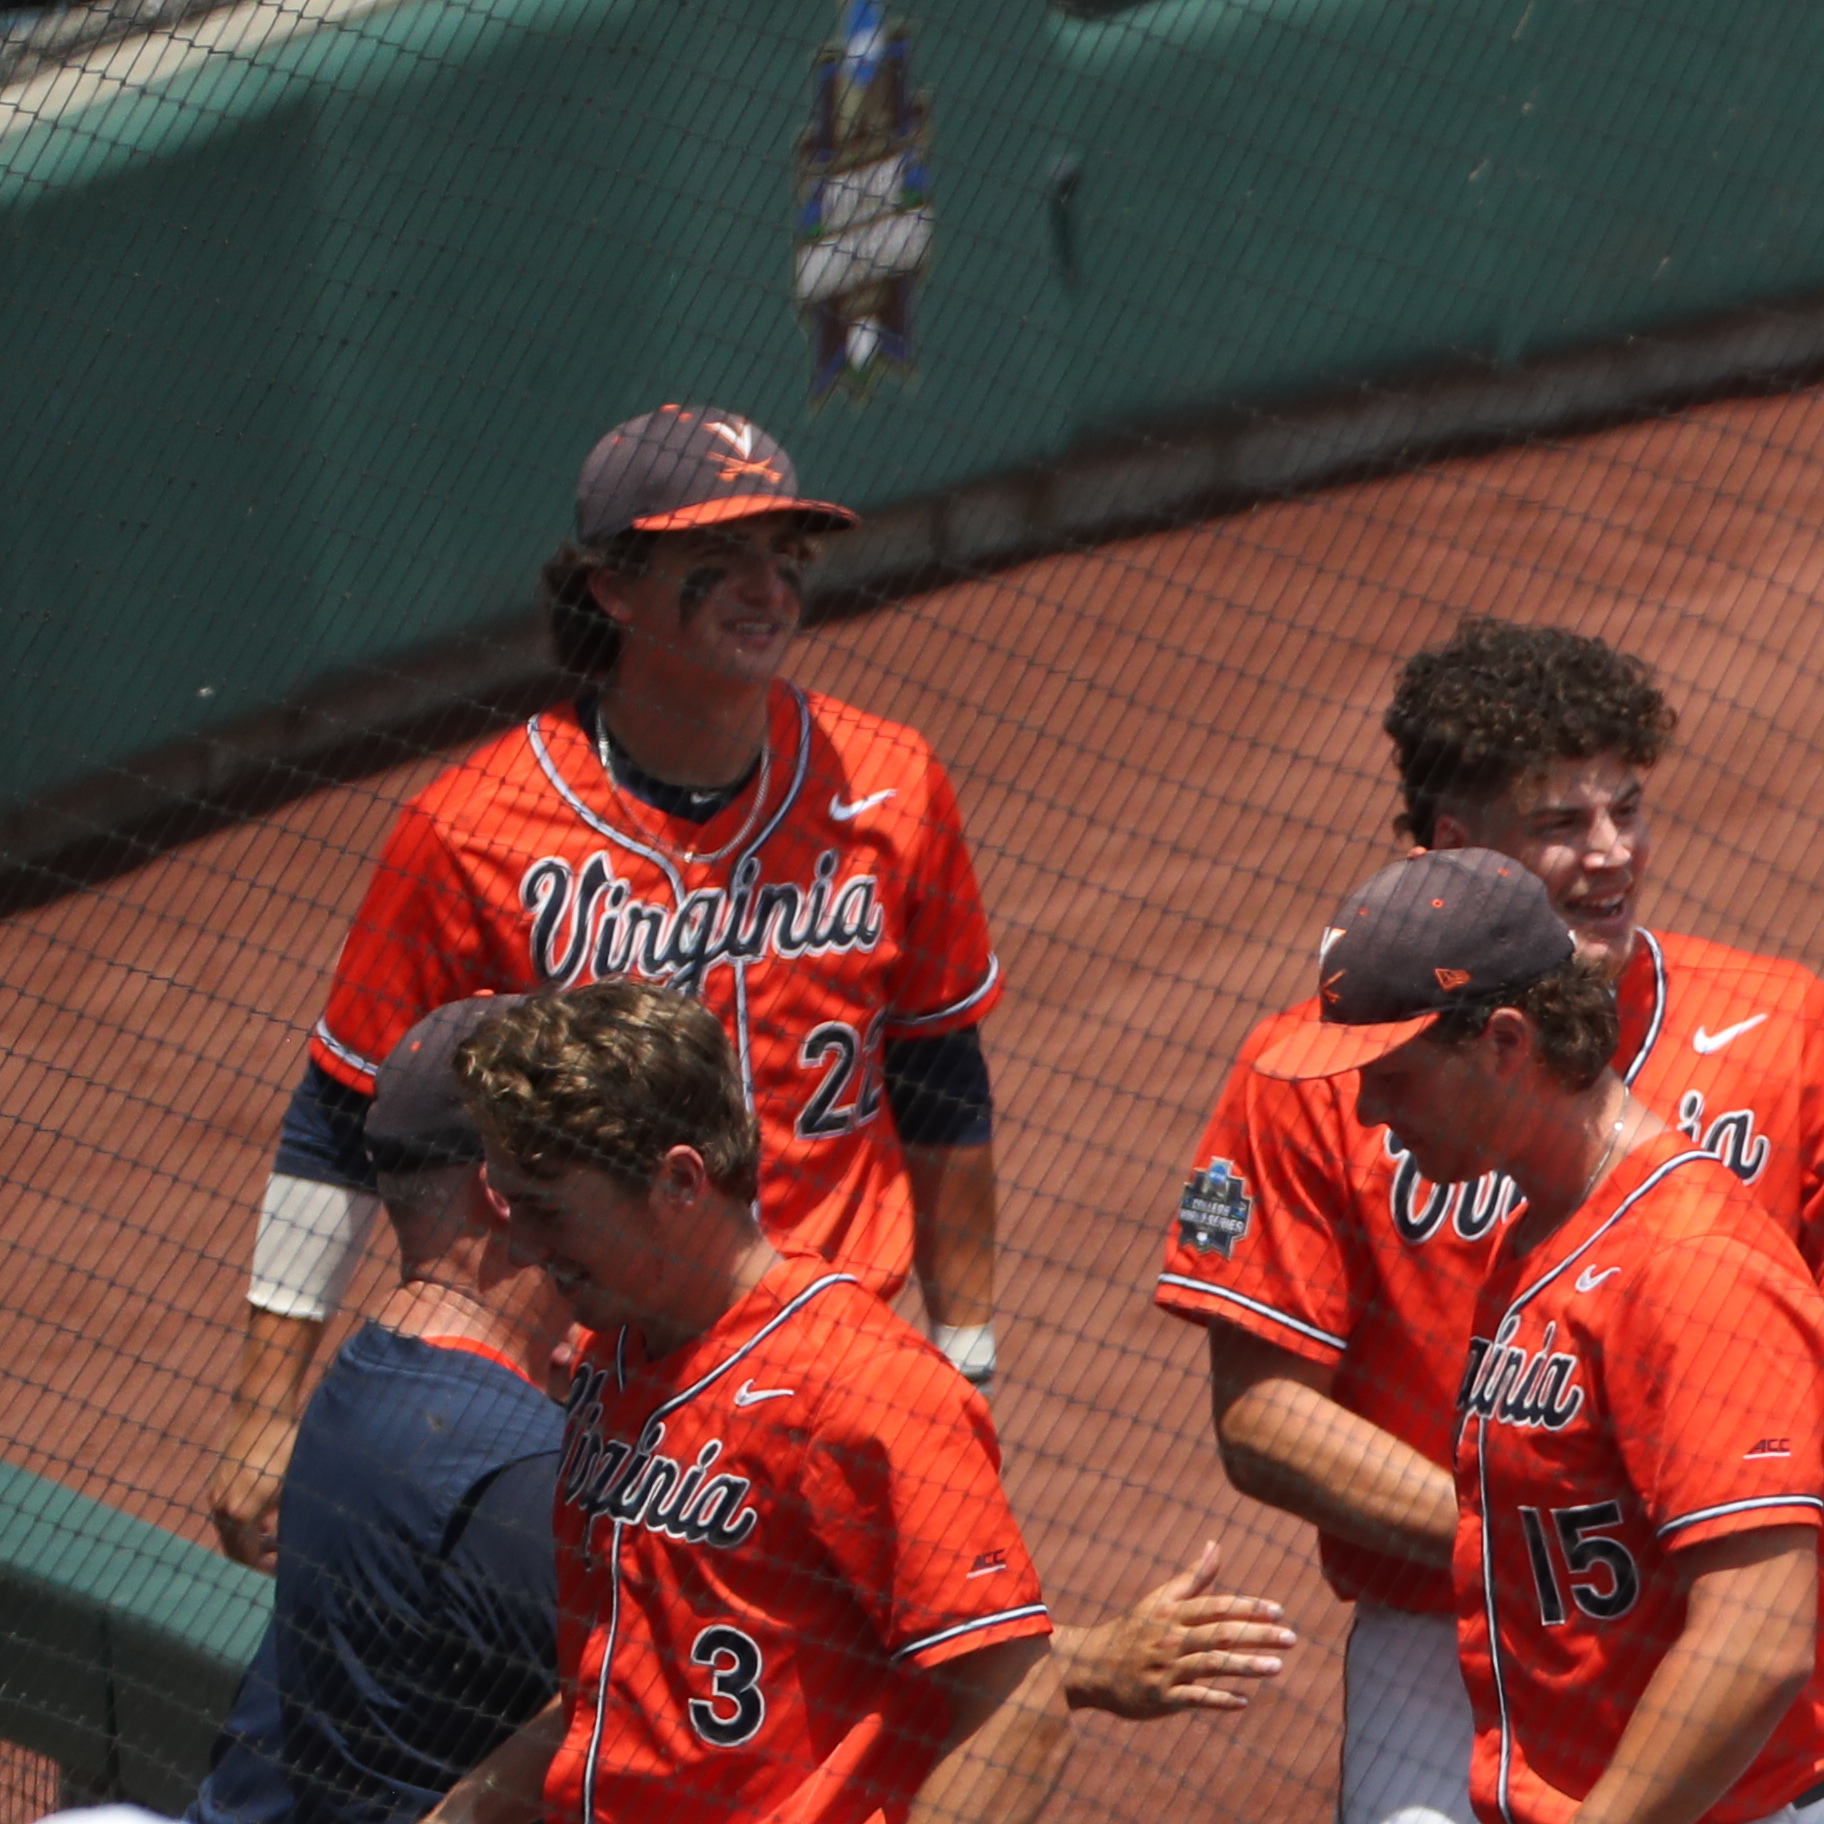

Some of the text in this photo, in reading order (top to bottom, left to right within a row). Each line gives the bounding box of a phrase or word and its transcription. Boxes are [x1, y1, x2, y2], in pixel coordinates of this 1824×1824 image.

[520, 850, 883, 998] Virginia
[1518, 1502, 1638, 1626] 15
[688, 1625, 763, 1747] 3
